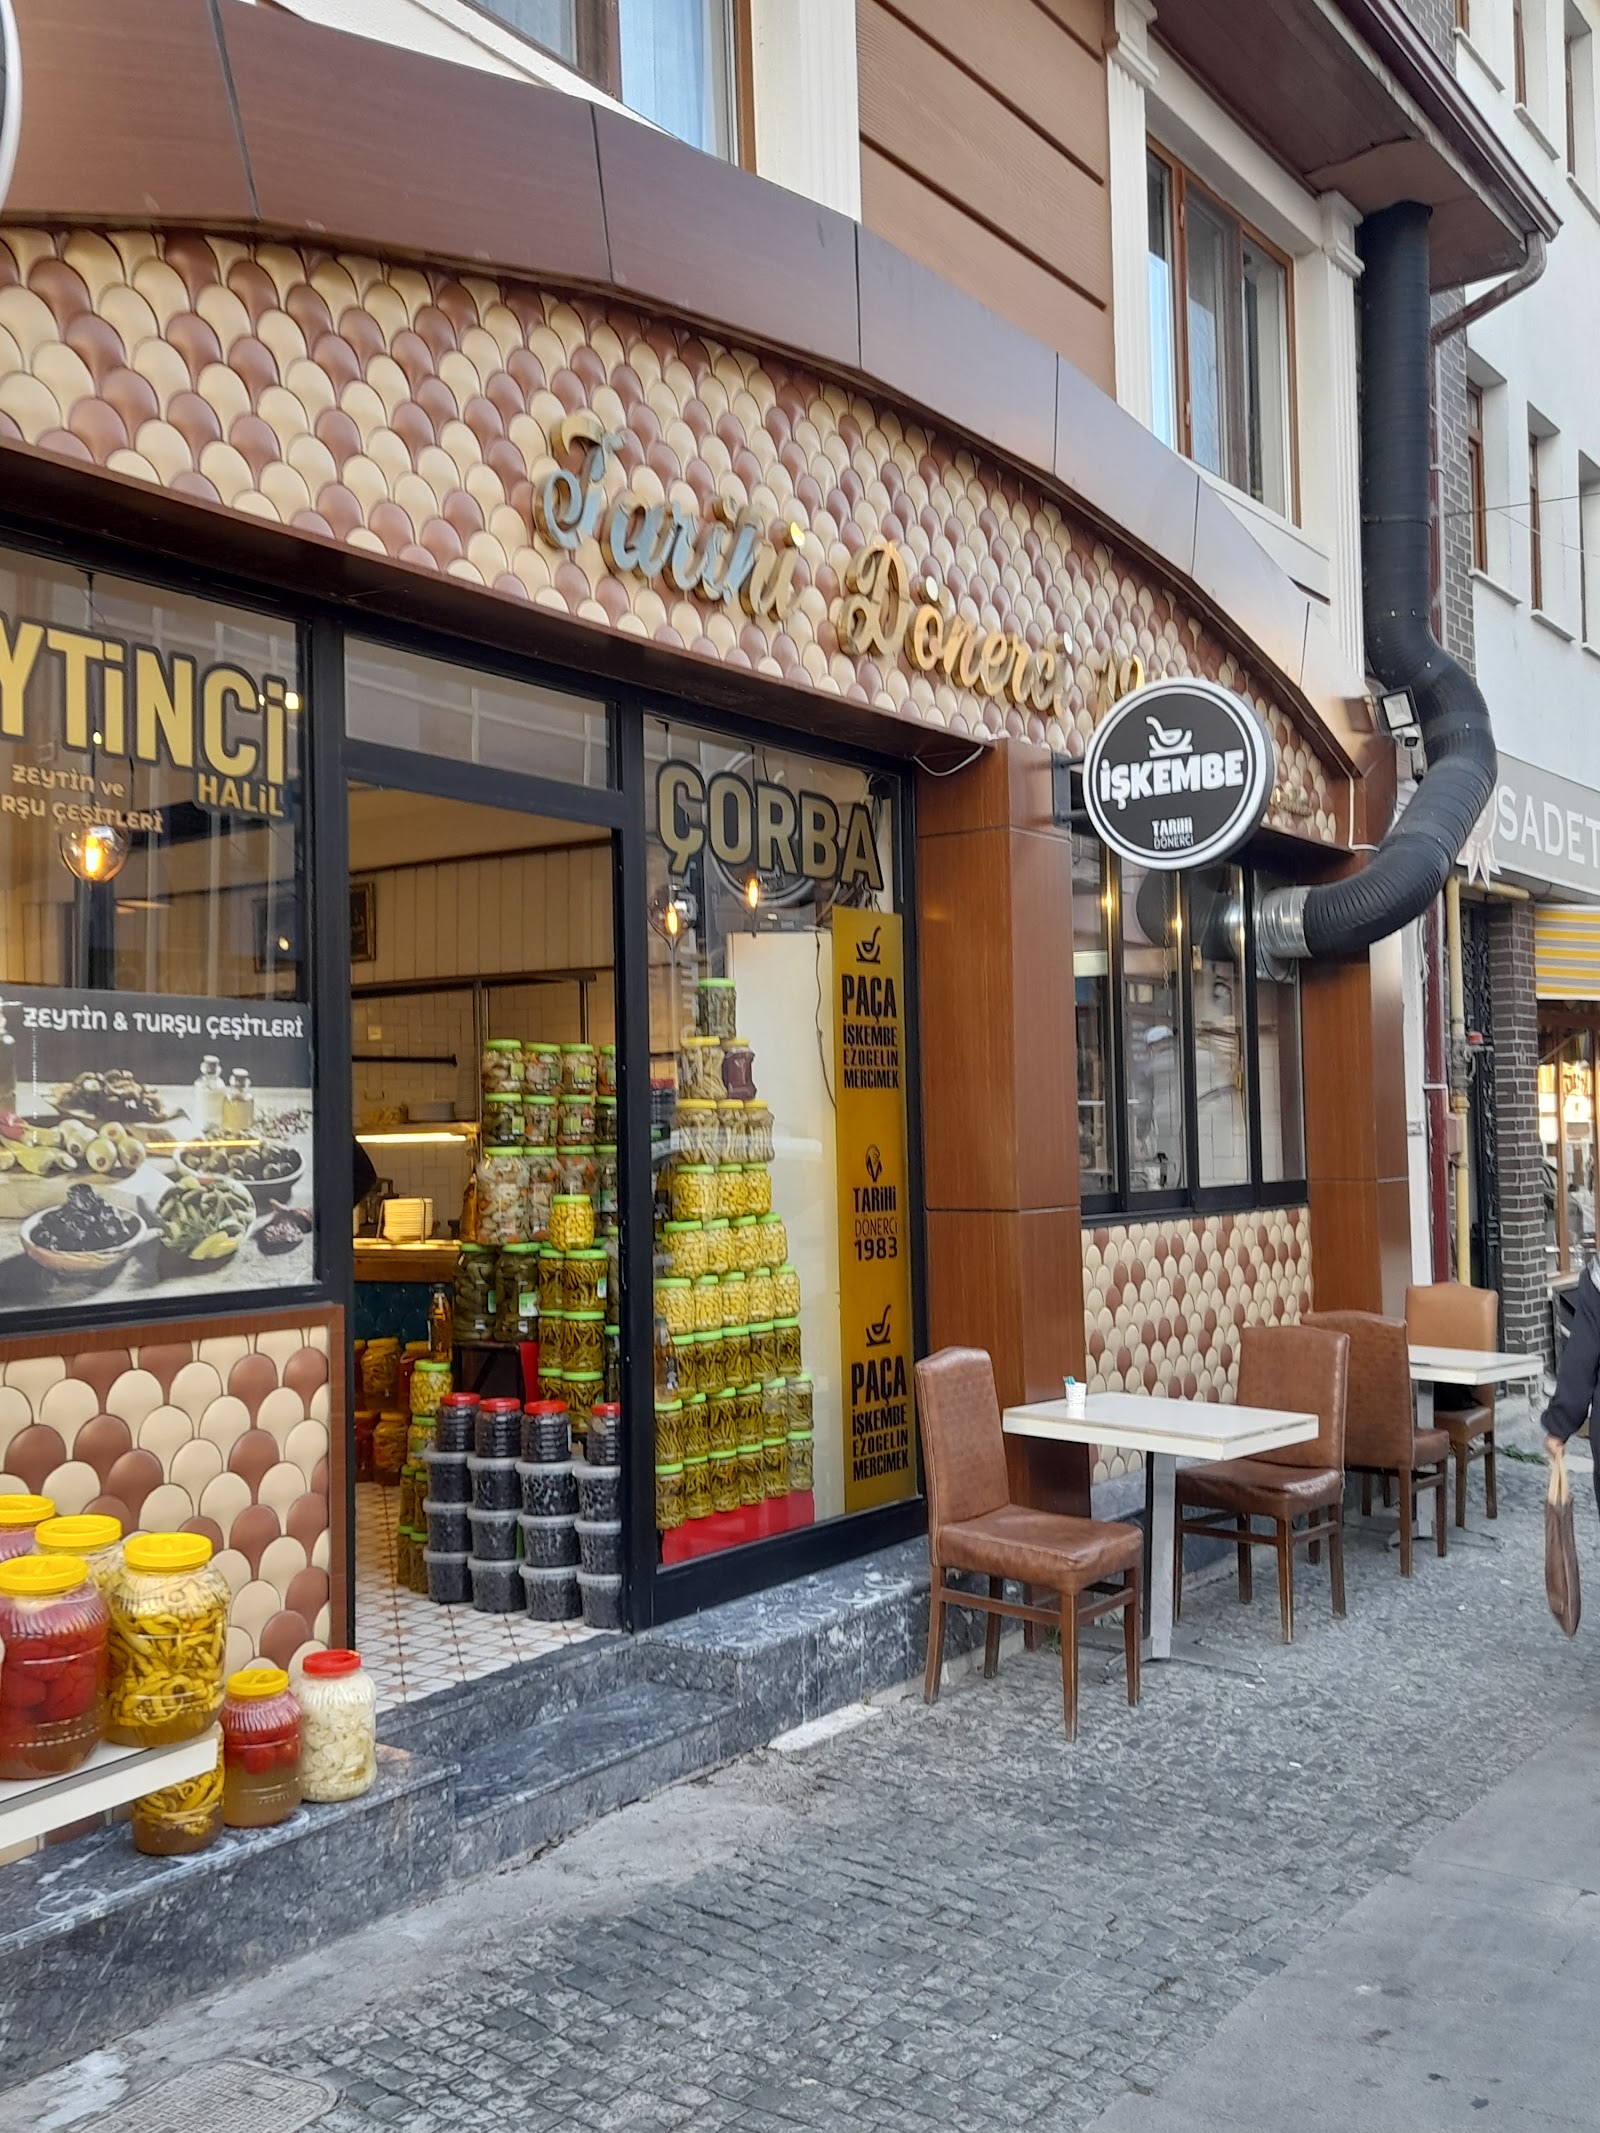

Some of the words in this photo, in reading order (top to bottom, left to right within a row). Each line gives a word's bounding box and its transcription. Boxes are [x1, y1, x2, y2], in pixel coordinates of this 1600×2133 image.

[1099, 749, 1244, 811] İŞKEMBE
[658, 762, 884, 890] ÇORBA
[841, 973, 897, 1024] PAÇA
[113, 1014, 129, 1032] &
[133, 1013, 201, 1039] TURŞU
[206, 1013, 304, 1041] ÇEŞİTLERİ
[843, 1018, 898, 1048] İŞKEMBE
[854, 1236, 898, 1262] 1983
[851, 1355, 907, 1407] PAÇA
[852, 1402, 907, 1440] İŞKEMBE
